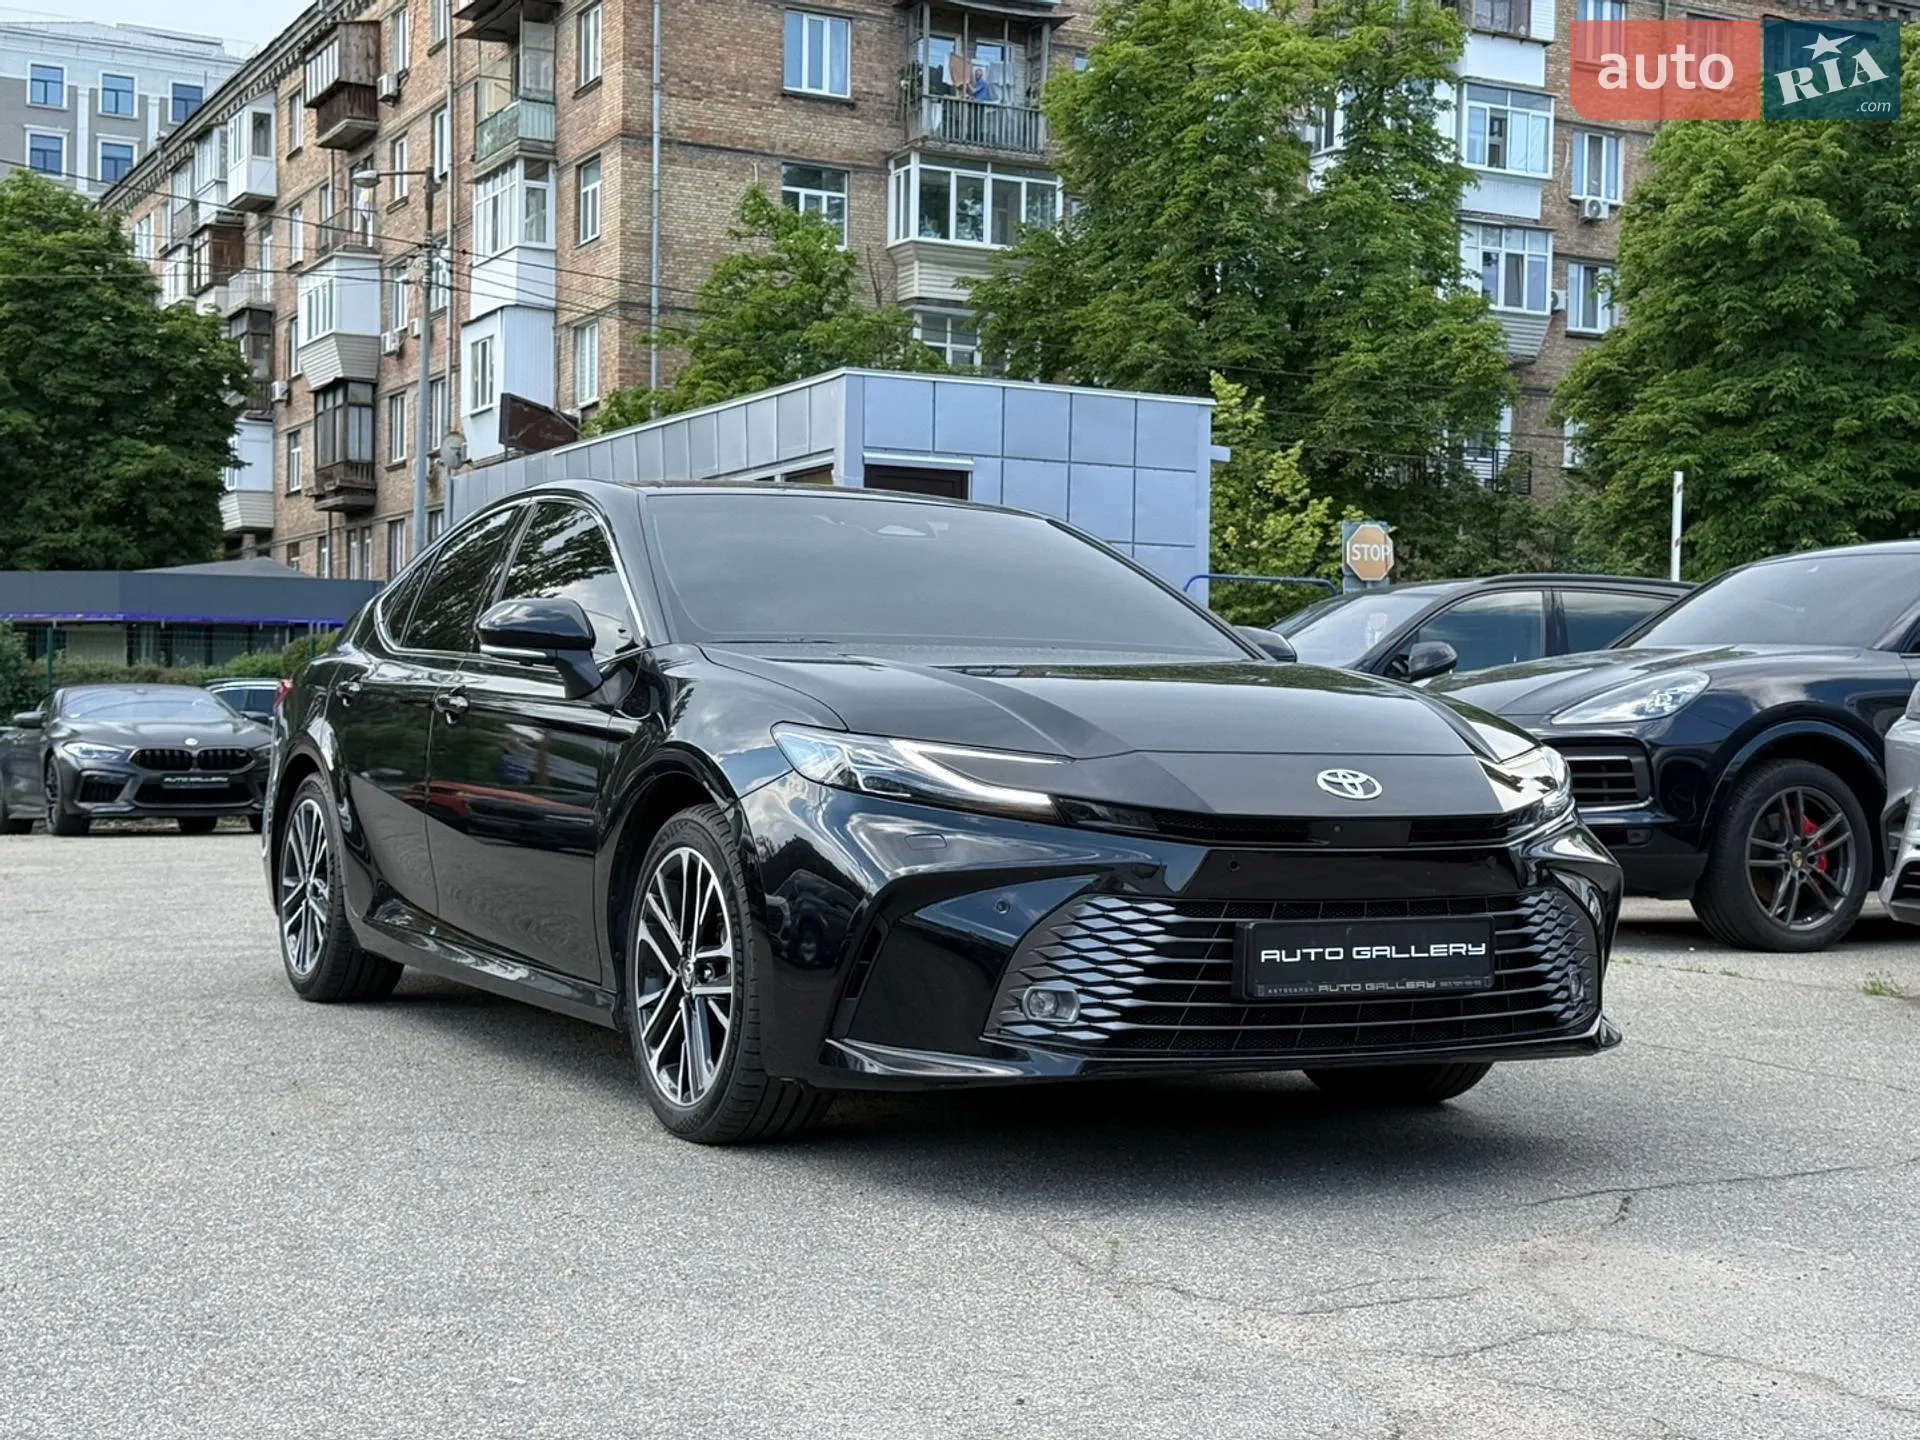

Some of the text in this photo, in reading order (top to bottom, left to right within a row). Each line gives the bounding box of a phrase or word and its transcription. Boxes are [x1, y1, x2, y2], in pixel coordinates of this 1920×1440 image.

[1350, 543, 1391, 562] STOP
[1260, 943, 1486, 963] AUTO GALLERY
[1318, 984, 1361, 992] AUTO
[1365, 980, 1436, 992] GALLERY
